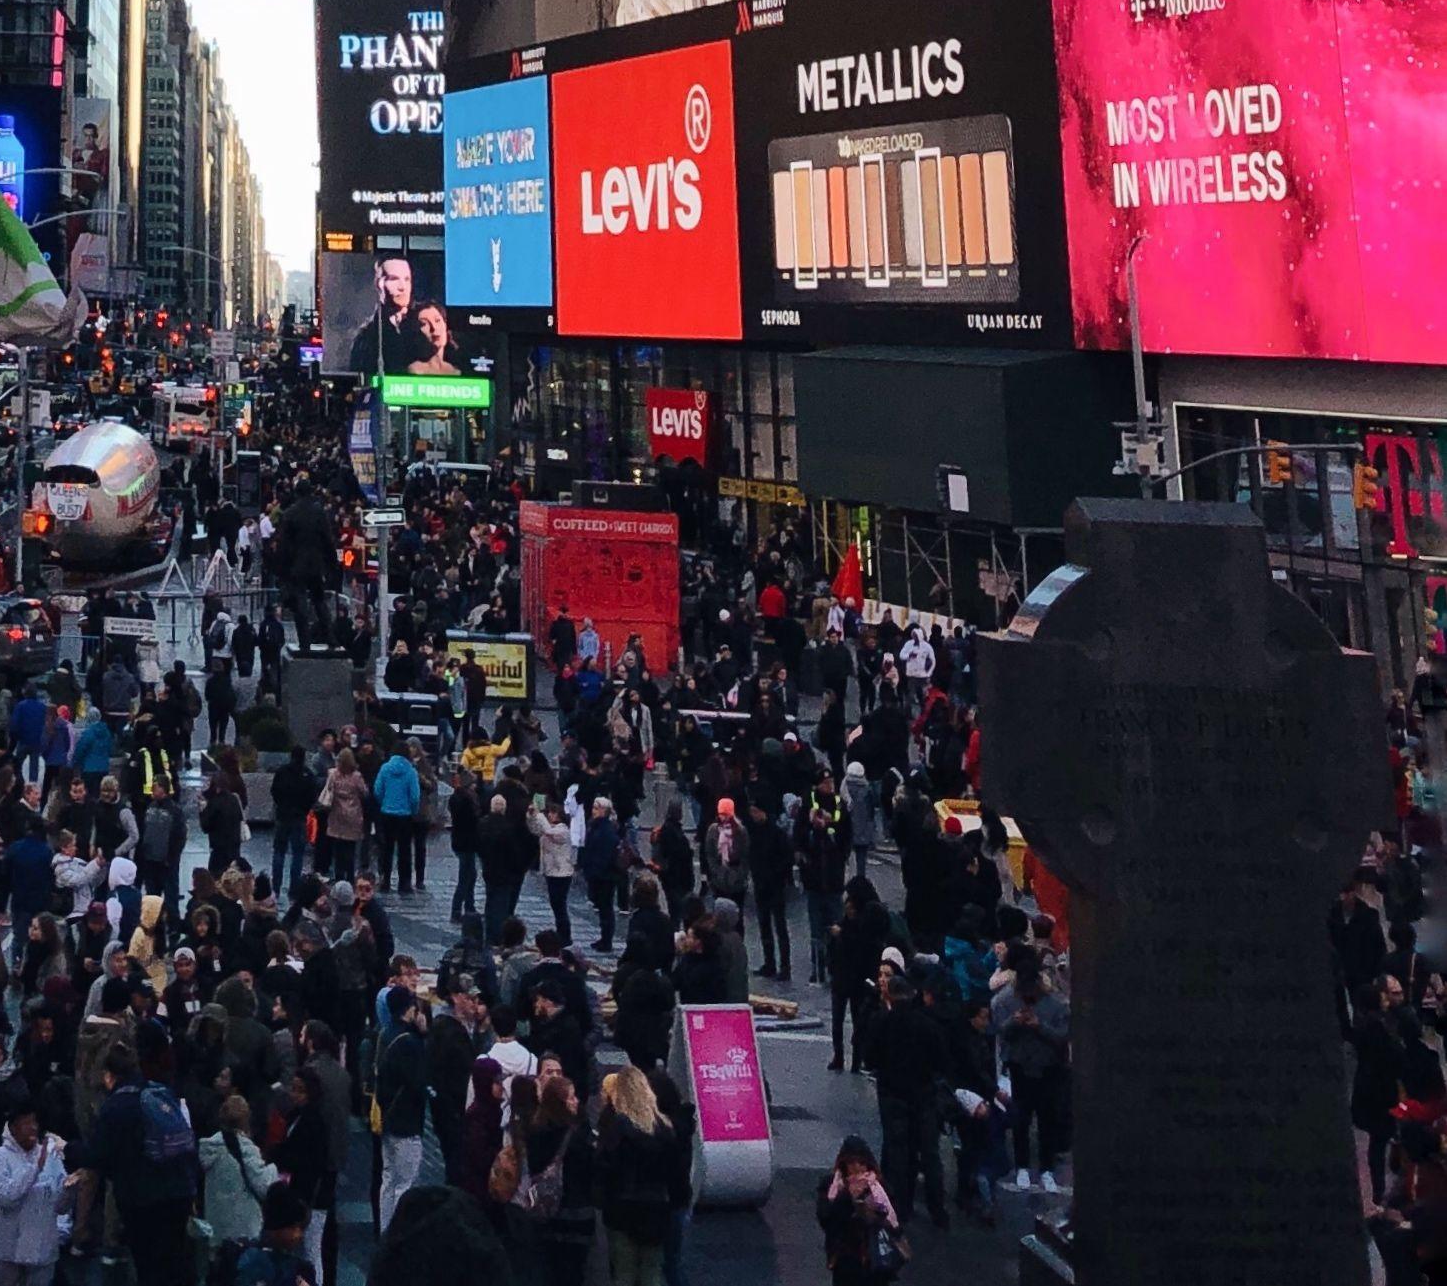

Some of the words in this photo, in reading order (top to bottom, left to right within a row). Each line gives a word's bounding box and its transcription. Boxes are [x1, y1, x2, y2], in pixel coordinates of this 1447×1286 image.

[753, 10, 785, 27] MARQUIS
[339, 33, 444, 70] PHAN
[393, 74, 421, 95] OF
[797, 37, 966, 114] METALLICS
[1106, 95, 1178, 147] MOST
[497, 127, 535, 166] YOUR
[1112, 162, 1140, 208] IN
[1147, 151, 1287, 206] WIRELESS
[398, 191, 429, 203] Theatre
[506, 178, 545, 215] HERE
[760, 310, 801, 326] SEPHORA
[967, 314, 1005, 332] URBAN
[1006, 314, 1043, 330] DECAY
[417, 384, 482, 400] FRIENDS
[553, 518, 608, 532] COFFEED
